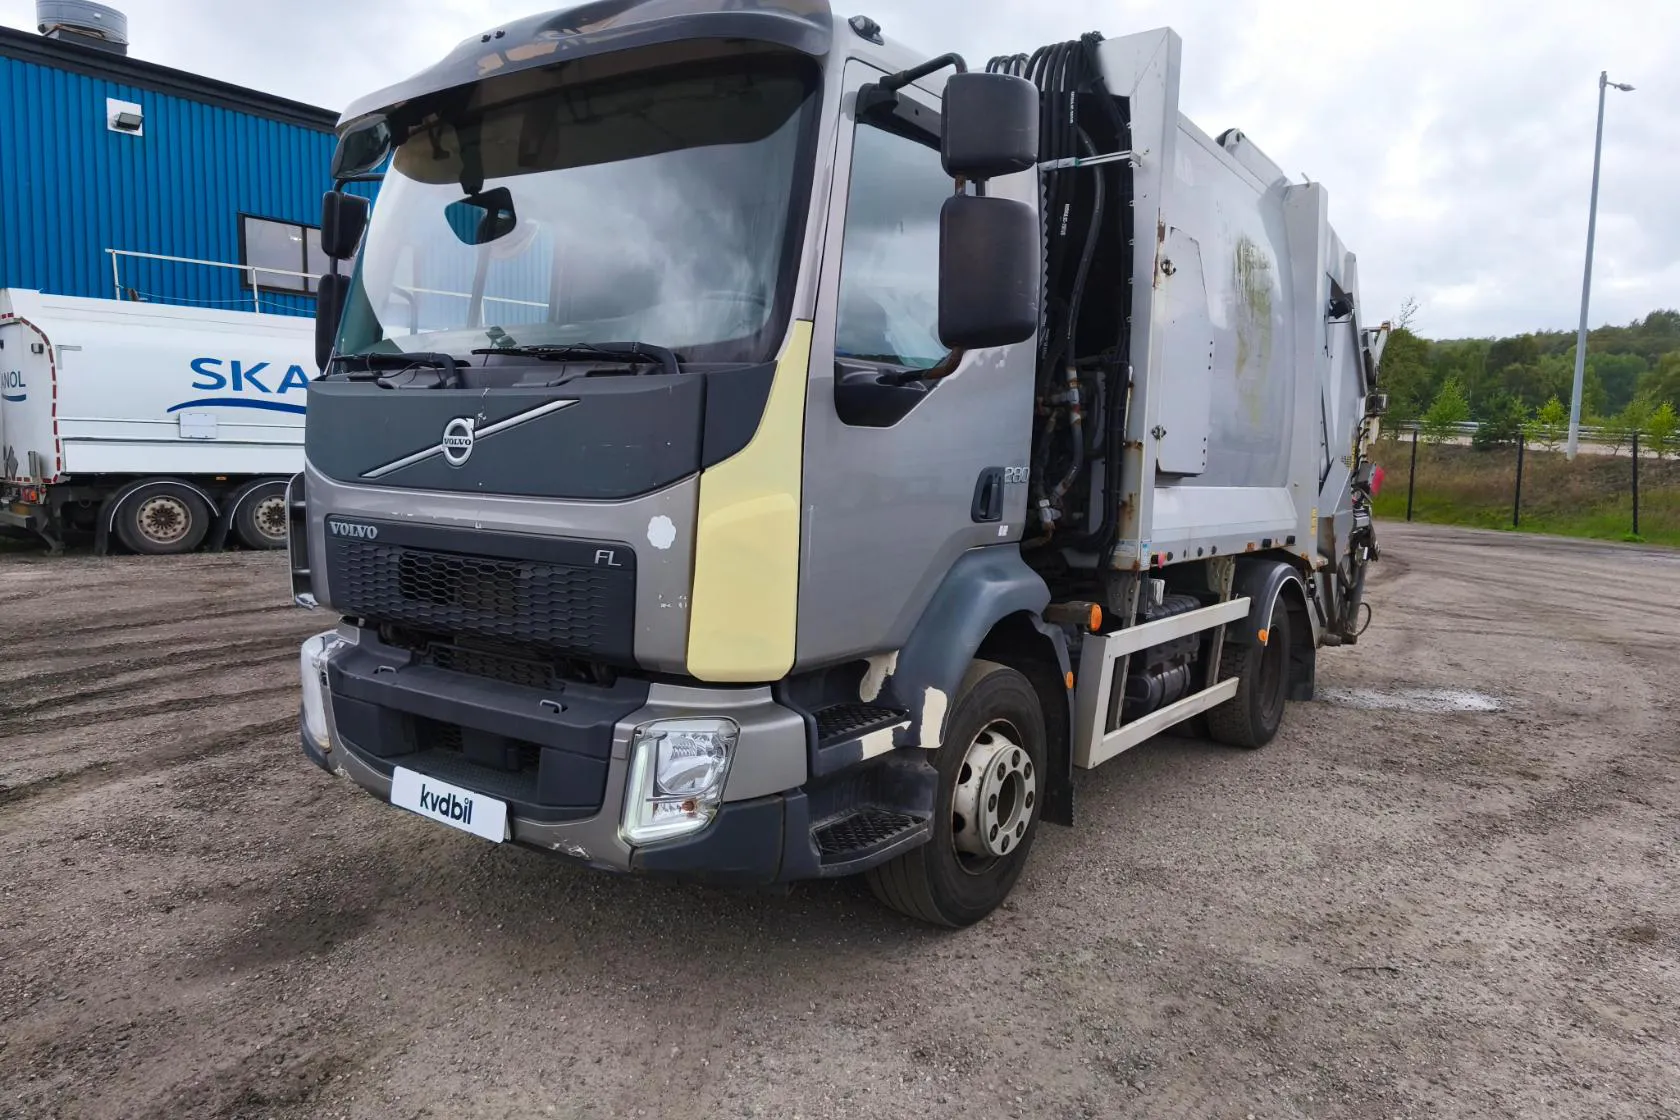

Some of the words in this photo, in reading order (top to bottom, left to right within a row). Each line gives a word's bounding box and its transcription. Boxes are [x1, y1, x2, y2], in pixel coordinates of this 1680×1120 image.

[1, 370, 26, 388] NOL
[190, 357, 309, 394] SKA
[443, 438, 472, 446] VOLVO
[1004, 466, 1030, 483] 280
[329, 521, 378, 539] VOLVO
[594, 549, 622, 566] FL
[419, 783, 473, 825] kvdbil
